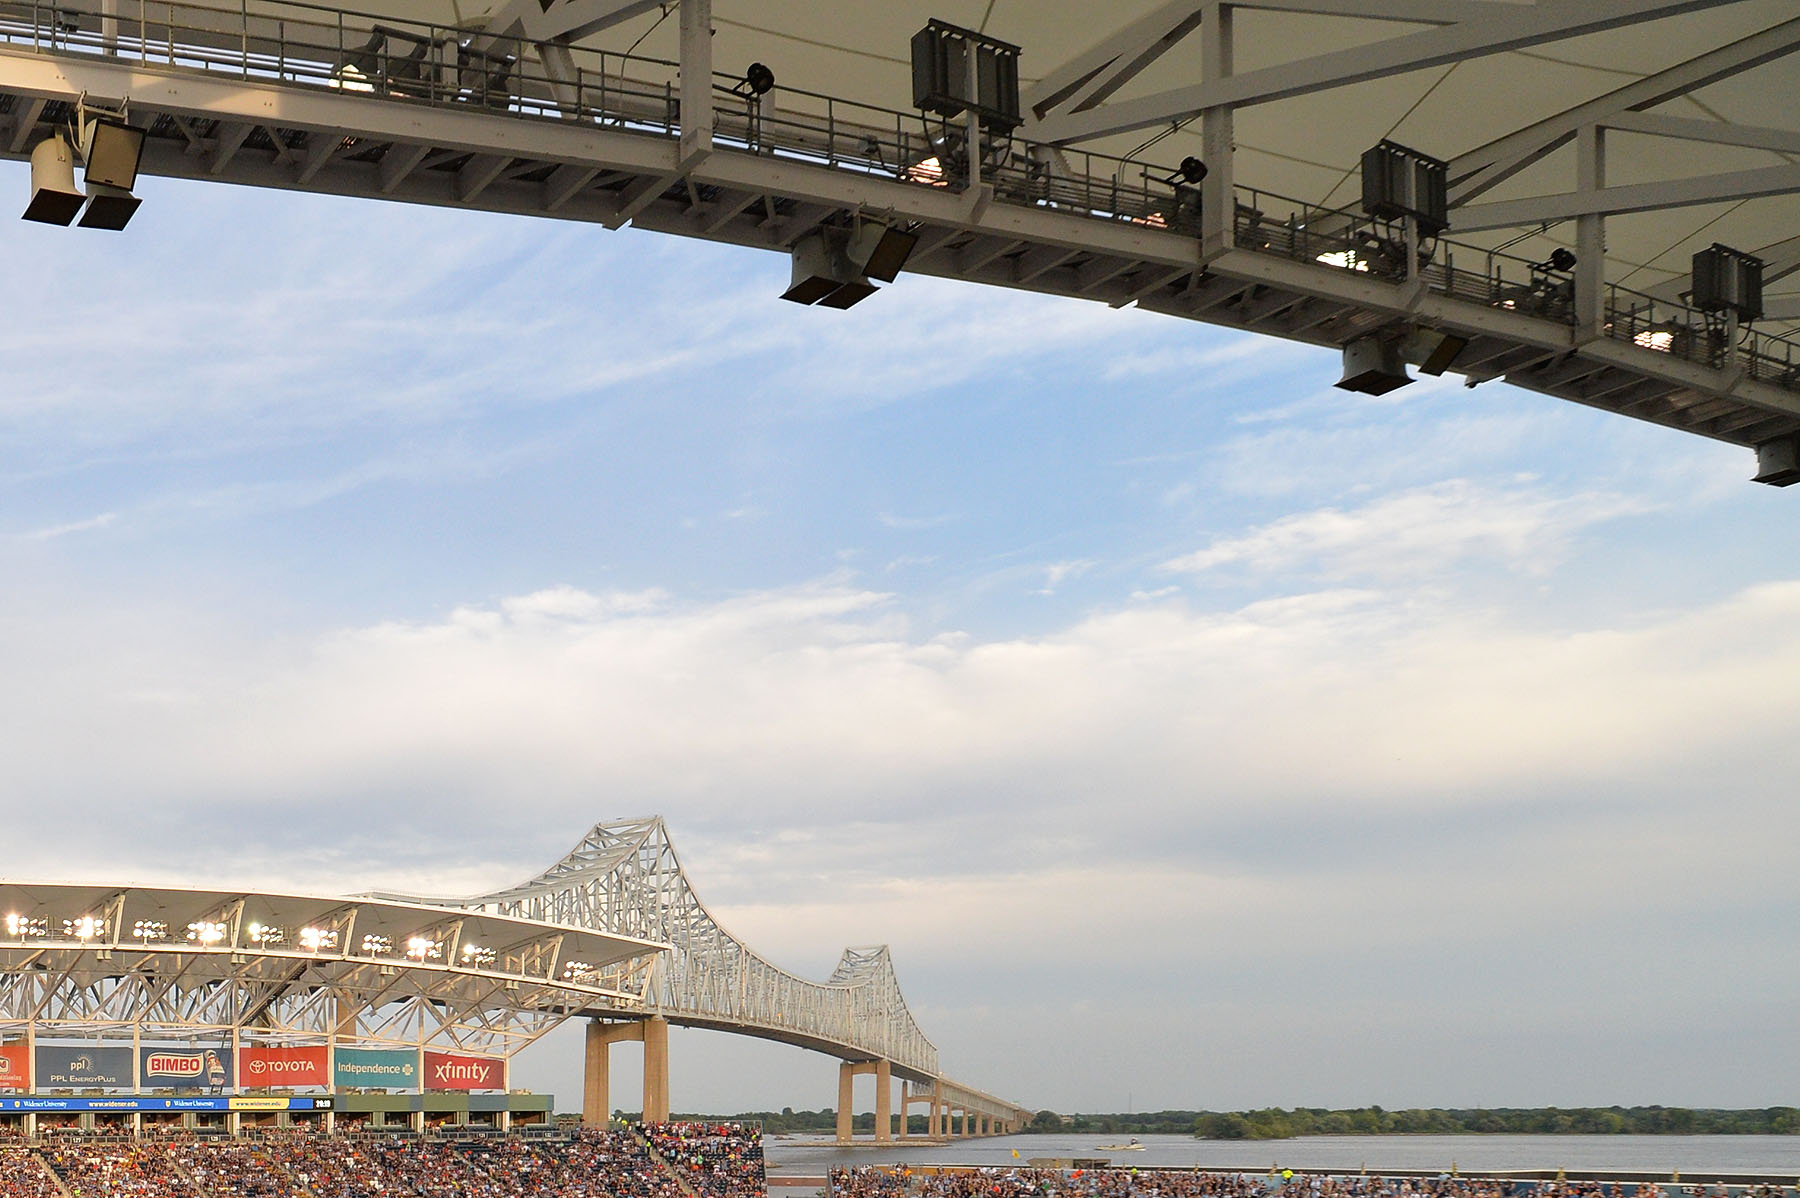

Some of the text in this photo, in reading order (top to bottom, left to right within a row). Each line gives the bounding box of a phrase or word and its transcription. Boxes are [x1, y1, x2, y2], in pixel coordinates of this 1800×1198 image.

[70, 1060, 86, 1073] ppl
[151, 1057, 200, 1072] BIMBO
[267, 1061, 315, 1072] TOYOTA
[338, 1062, 400, 1075] Independence
[435, 1061, 490, 1083] xfinity
